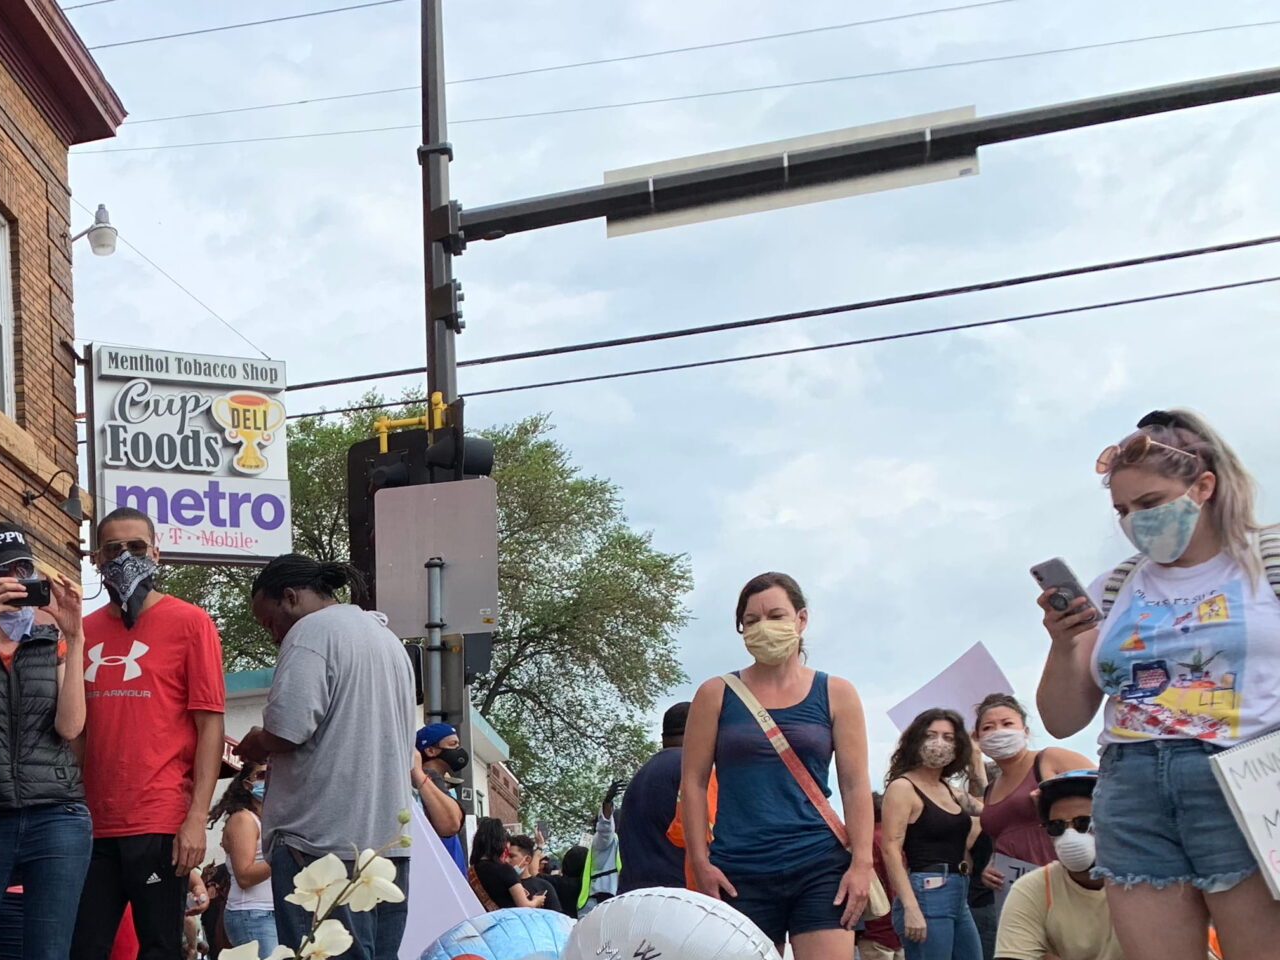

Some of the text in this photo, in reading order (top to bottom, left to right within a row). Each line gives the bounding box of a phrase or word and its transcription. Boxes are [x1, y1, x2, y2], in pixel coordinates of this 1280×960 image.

[108, 352, 278, 384] Menthol Tobacco Shop
[118, 380, 205, 435] Cup
[231, 408, 268, 431] DELI
[107, 424, 220, 468] Foods
[116, 480, 285, 530] metro
[103, 689, 152, 698] ARMOUR
